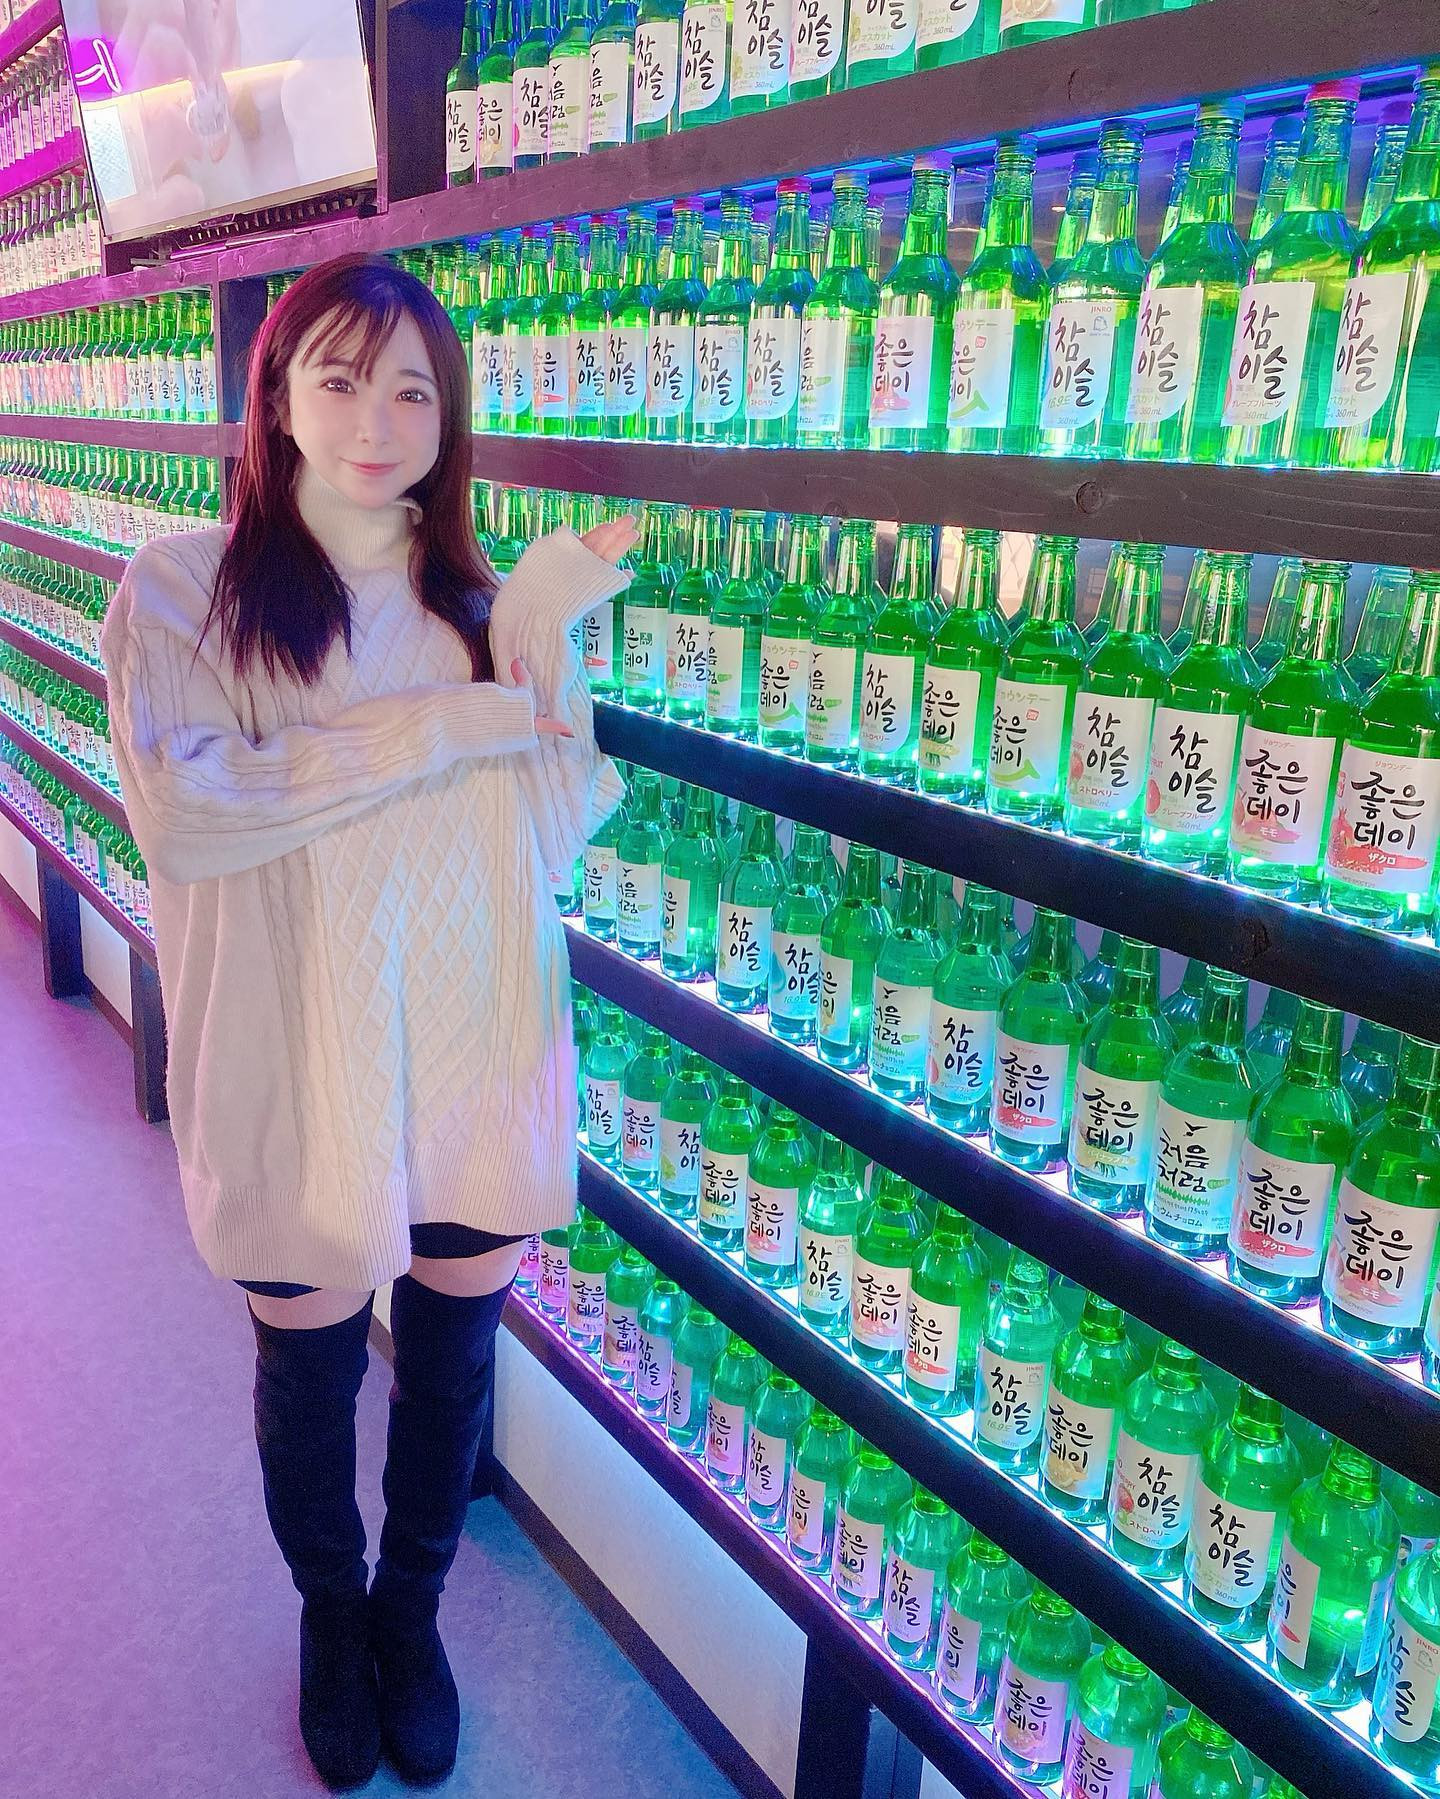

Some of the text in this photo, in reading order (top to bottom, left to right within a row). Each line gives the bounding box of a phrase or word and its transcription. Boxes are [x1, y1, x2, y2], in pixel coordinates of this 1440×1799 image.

[746, 0, 775, 32] 참
[637, 34, 656, 67] 참
[685, 19, 706, 55] 참
[747, 28, 784, 70] 이슬
[798, 14, 832, 58] 이슬
[638, 63, 665, 101] 이슬
[685, 50, 716, 90] 이슬
[521, 78, 544, 107] 참
[448, 98, 461, 125] 참
[477, 97, 503, 126] 좋은
[448, 123, 470, 152] 이슬
[1090, 306, 1112, 314] JINRO
[1141, 300, 1171, 346] 참
[1243, 300, 1280, 350] 참
[1344, 288, 1371, 340] 참
[480, 342, 499, 369] 참
[577, 339, 597, 368] 참
[608, 334, 627, 365] 참
[653, 336, 675, 368] 참
[700, 338, 723, 372] 참
[753, 329, 776, 363] 참
[875, 334, 914, 370] 좋은
[1055, 317, 1086, 363] 참
[609, 362, 637, 396] 이슬
[754, 360, 785, 397] 이슬
[1137, 341, 1179, 393] 이슬
[1238, 345, 1288, 400] 이슬
[1336, 334, 1379, 392] 이슬
[504, 368, 524, 397] 이슬
[578, 366, 604, 397] 이슬
[654, 365, 685, 401] 이슬
[701, 368, 734, 407] 이슬
[875, 371, 910, 393] 데이
[1053, 357, 1095, 408] 이슬
[676, 623, 700, 653] 참
[677, 651, 707, 682] 이슬
[760, 658, 790, 690] 좋은
[866, 664, 888, 699] 참
[760, 691, 787, 709] 데이
[866, 697, 897, 733] 이슬
[924, 680, 960, 718] 좋은
[922, 719, 955, 742] 데이
[993, 705, 1027, 744] 좋은
[1088, 706, 1121, 748] 참
[991, 745, 1022, 768] 데이
[1170, 724, 1208, 770] 참
[1087, 746, 1129, 788] 이슬
[1245, 748, 1309, 795] 좋은
[1079, 785, 1120, 797] ストロベリー
[1168, 767, 1218, 814] 이슬
[1351, 771, 1425, 820] 좋은
[1246, 796, 1301, 824] 데이
[1353, 821, 1416, 850] 데이
[1368, 853, 1396, 865] ザクロ
[728, 912, 753, 943] 참
[729, 940, 761, 971] 이슬
[785, 943, 813, 975] 참
[788, 970, 819, 1004] 이슬
[943, 1017, 974, 1053] 참
[944, 1052, 983, 1088] 이슬
[999, 1052, 1050, 1091] 좋은
[587, 1084, 604, 1110] 참
[1003, 1088, 1045, 1113] 데이
[1082, 1087, 1140, 1128] 좋은
[590, 1109, 614, 1135] 이슬
[624, 1107, 656, 1133] 좋은
[625, 1133, 653, 1149] 데이
[678, 1128, 699, 1154] 참
[1086, 1126, 1134, 1152] 데이
[1159, 1127, 1210, 1170] 처음
[702, 1160, 739, 1188] 좋은
[1157, 1154, 1208, 1193] 처럼
[705, 1188, 737, 1205] 데이
[749, 1192, 784, 1224] 좋은
[1247, 1168, 1310, 1216] 좋은
[750, 1222, 781, 1241] 데이
[1250, 1209, 1303, 1241] 데이
[1344, 1210, 1413, 1262] 좋은
[807, 1240, 832, 1272] 참
[1262, 1239, 1286, 1253] ザクロ
[541, 1251, 567, 1275] 좋은
[1346, 1253, 1404, 1290] 데이
[542, 1273, 565, 1288] 데이
[572, 1280, 604, 1302] 좋은
[810, 1271, 844, 1301] 이슬
[857, 1273, 901, 1306] 좋은
[1360, 1287, 1379, 1299] モモ
[577, 1302, 604, 1318] 데이
[861, 1304, 898, 1325] 데이
[907, 1303, 943, 1342] 좋은
[639, 1335, 654, 1363] 참
[908, 1336, 939, 1362] 데이
[639, 1362, 660, 1386] 이슬
[991, 1367, 1022, 1403] 참
[991, 1402, 1032, 1436] 이슬
[1049, 1404, 1094, 1447] 좋은
[750, 1433, 766, 1463] 참
[1049, 1437, 1089, 1469] 데이
[750, 1461, 773, 1490] 이슬
[1137, 1457, 1173, 1496] 참
[1137, 1494, 1180, 1529] 이슬
[1209, 1503, 1247, 1549] 참
[839, 1518, 868, 1556] 좋은
[1129, 1520, 1171, 1537] ストロベリー
[892, 1560, 914, 1595] 참
[1208, 1542, 1255, 1587] 이슬
[891, 1590, 921, 1626] 이슬
[1388, 1619, 1411, 1675] 참
[1416, 1637, 1438, 1654] JINRO
[1008, 1679, 1053, 1725] 좋은
[1007, 1708, 1047, 1736] 데이
[1074, 1732, 1114, 1782] 좋은
